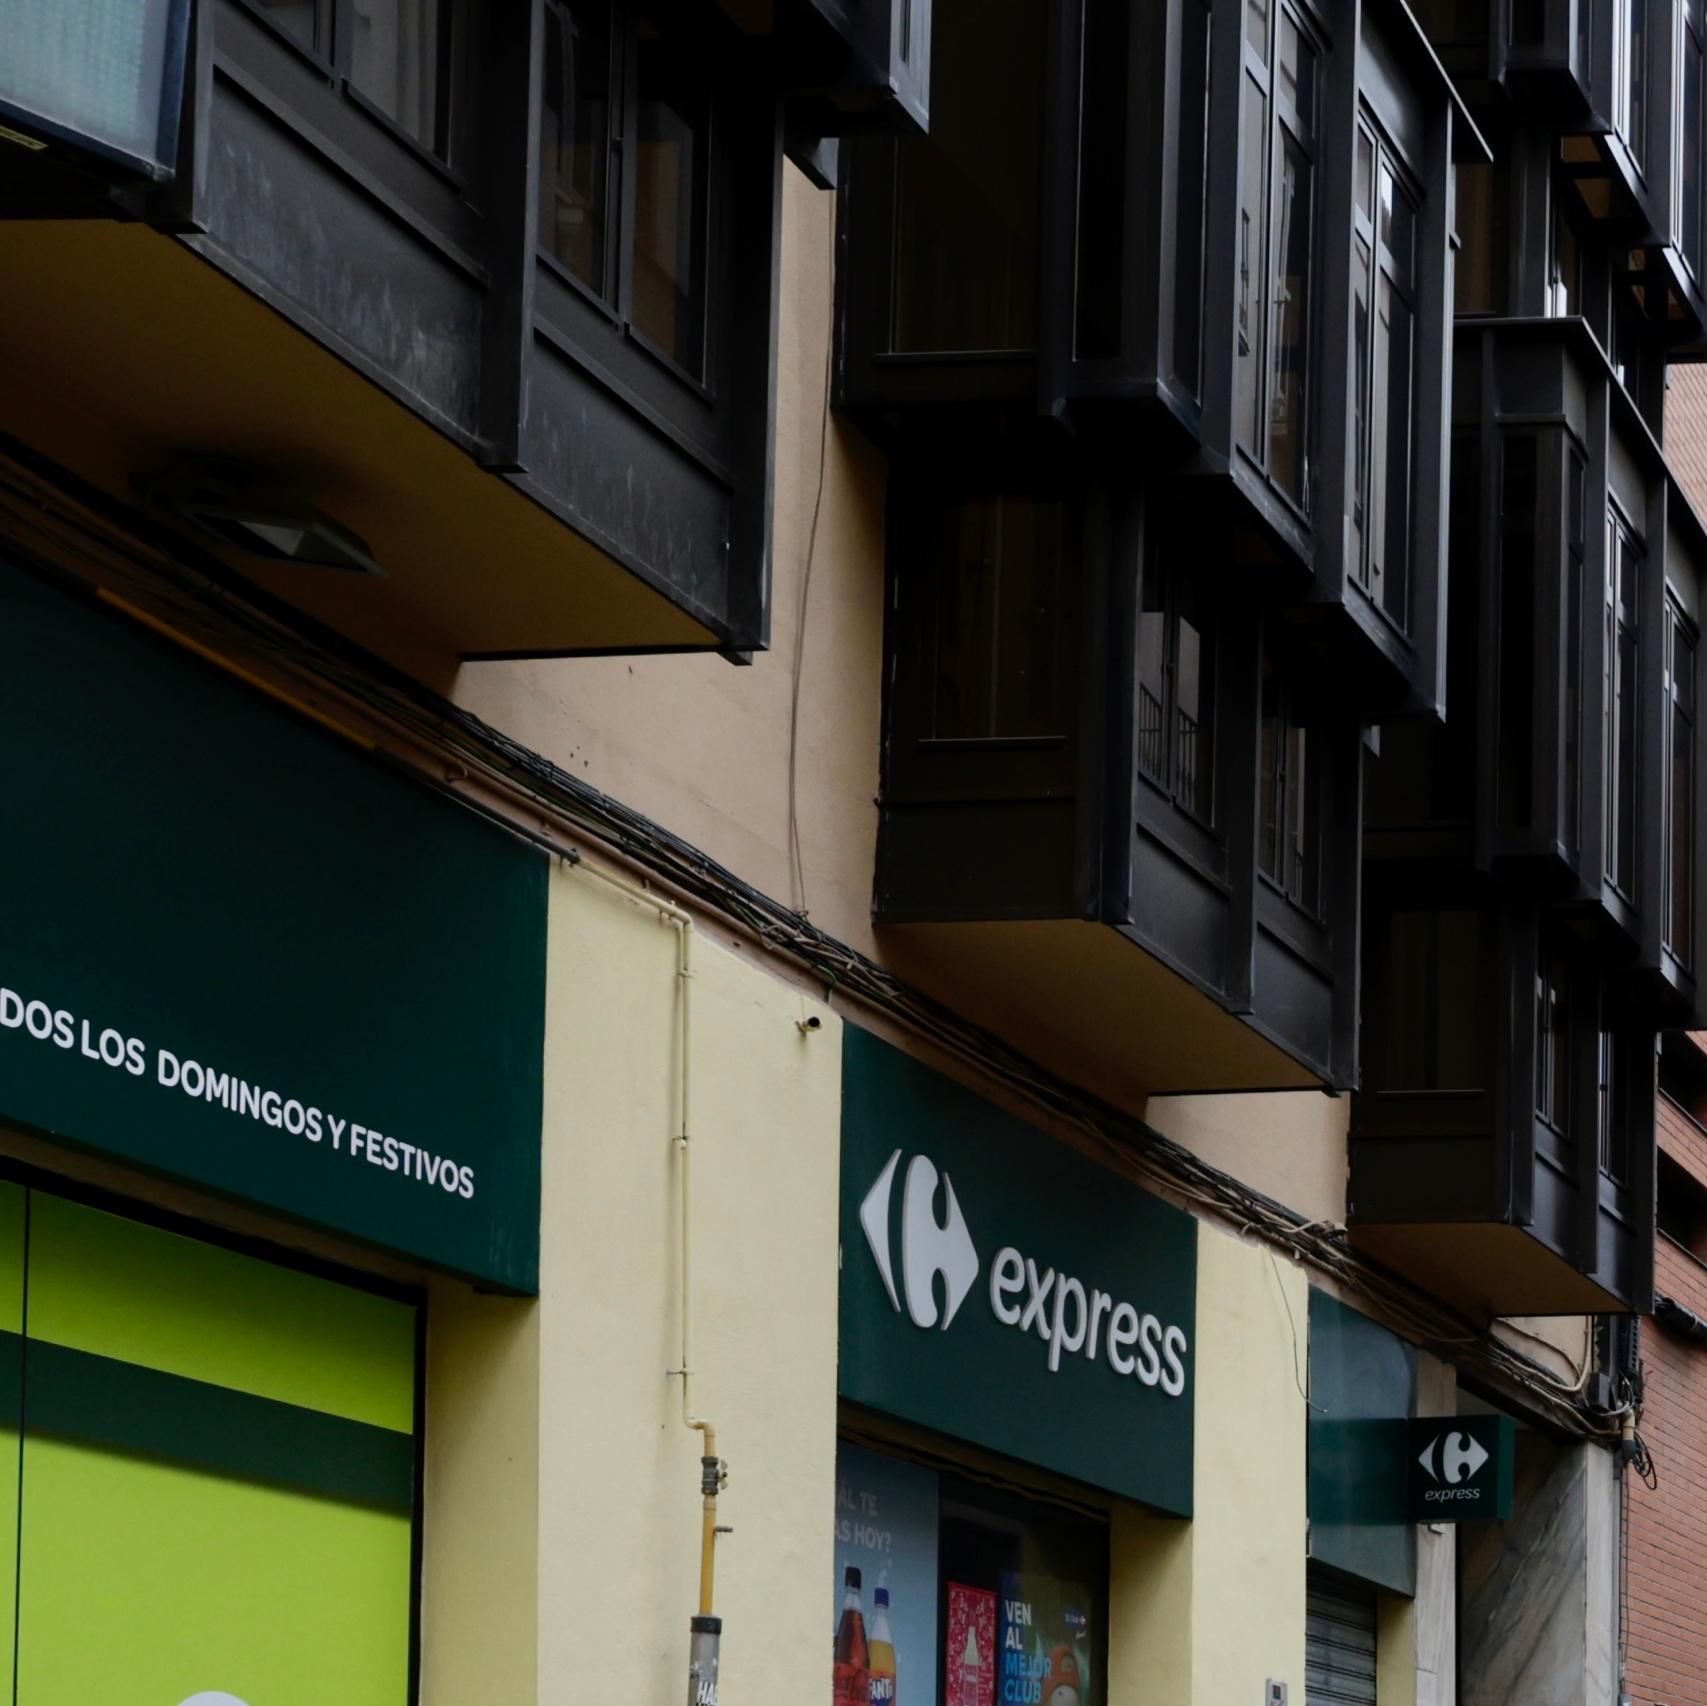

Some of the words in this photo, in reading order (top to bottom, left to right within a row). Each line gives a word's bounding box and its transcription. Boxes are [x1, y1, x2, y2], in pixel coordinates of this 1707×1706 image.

[81, 1018, 146, 1076] LOS
[157, 1049, 323, 1142] DOMINGOS
[327, 1114, 346, 1149] Y
[350, 1123, 475, 1199] FESTIVOS
[990, 1246, 1187, 1398] express
[860, 1492, 878, 1517] TE
[1424, 1488, 1480, 1503] express
[854, 1522, 892, 1553] HOY?
[1004, 1600, 1032, 1626] VEN
[1005, 1626, 1023, 1650] AL
[1005, 1652, 1053, 1680] MEJOR
[1004, 1679, 1042, 1704] CLUB
